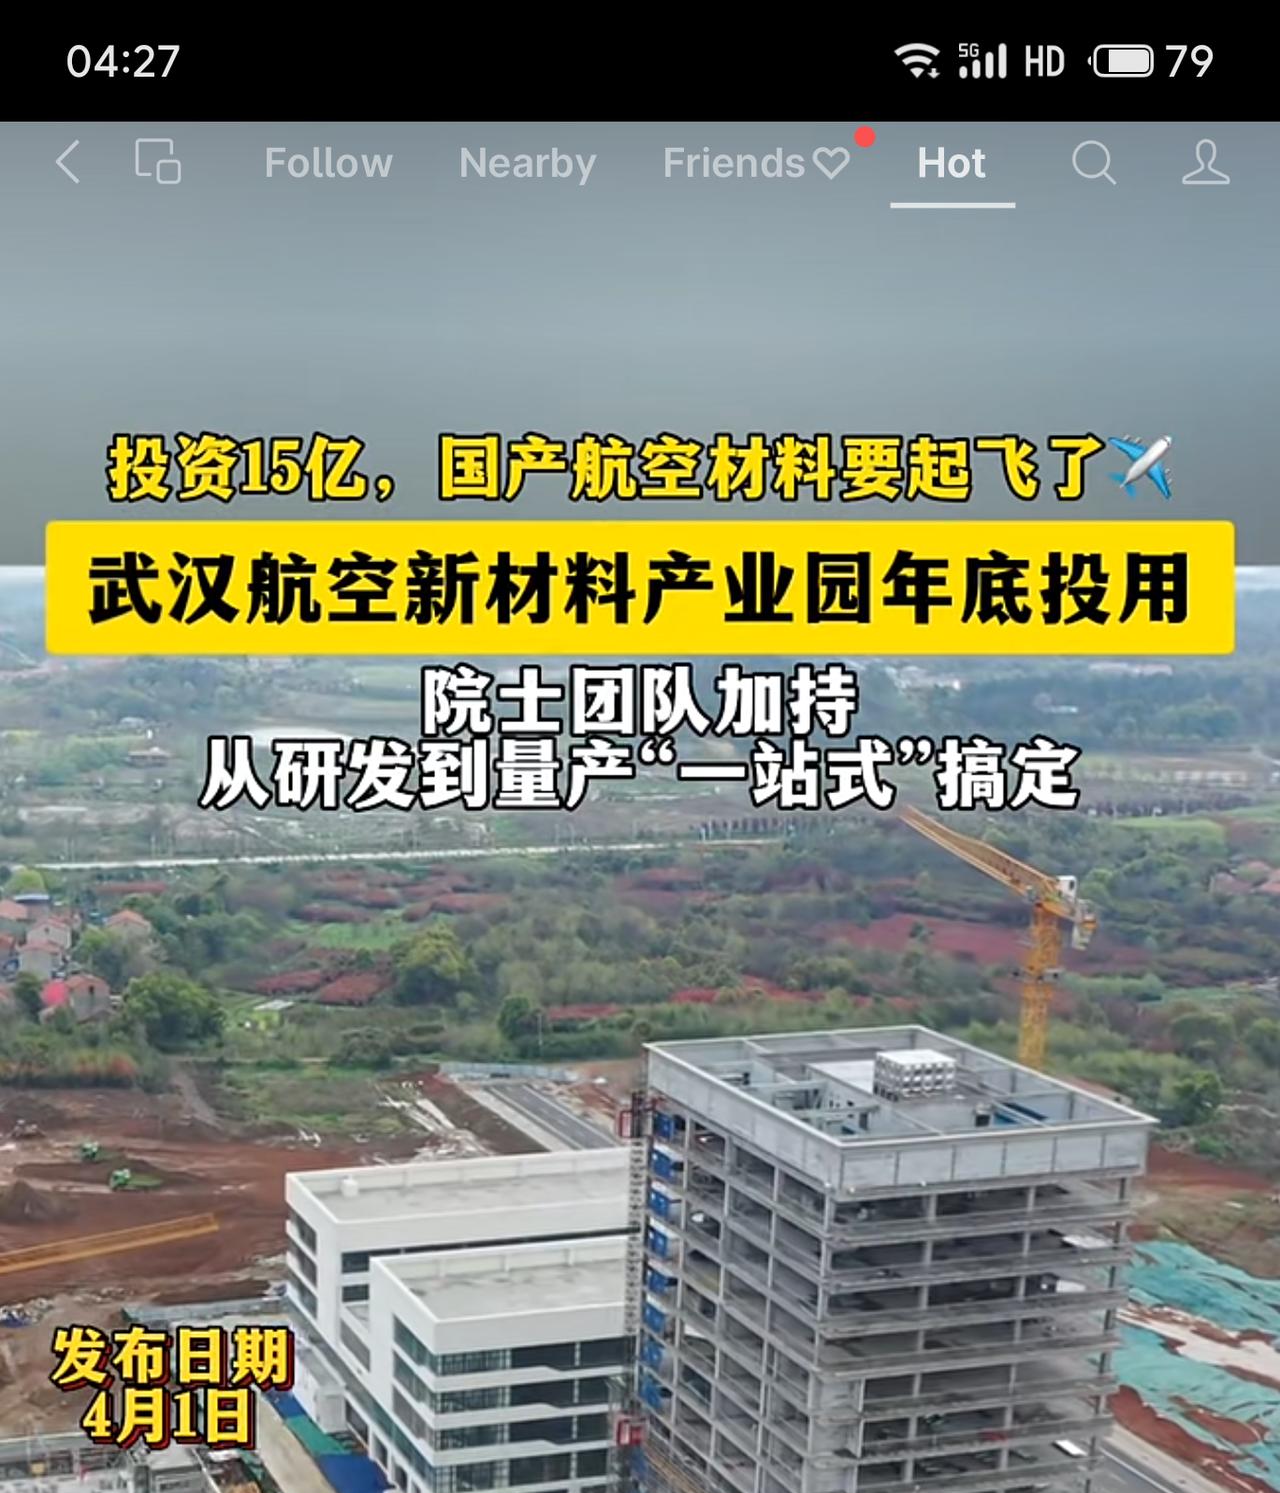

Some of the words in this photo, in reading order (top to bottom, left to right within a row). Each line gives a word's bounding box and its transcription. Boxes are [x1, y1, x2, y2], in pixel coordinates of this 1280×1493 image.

[67, 45, 179, 77] 04:27
[959, 43, 979, 57] 5G
[1026, 45, 1064, 76] HD
[1166, 45, 1213, 77] 79
[267, 147, 392, 177] Follow
[461, 148, 596, 185] Nearby
[665, 147, 805, 177] Friends
[920, 147, 986, 178] Hot
